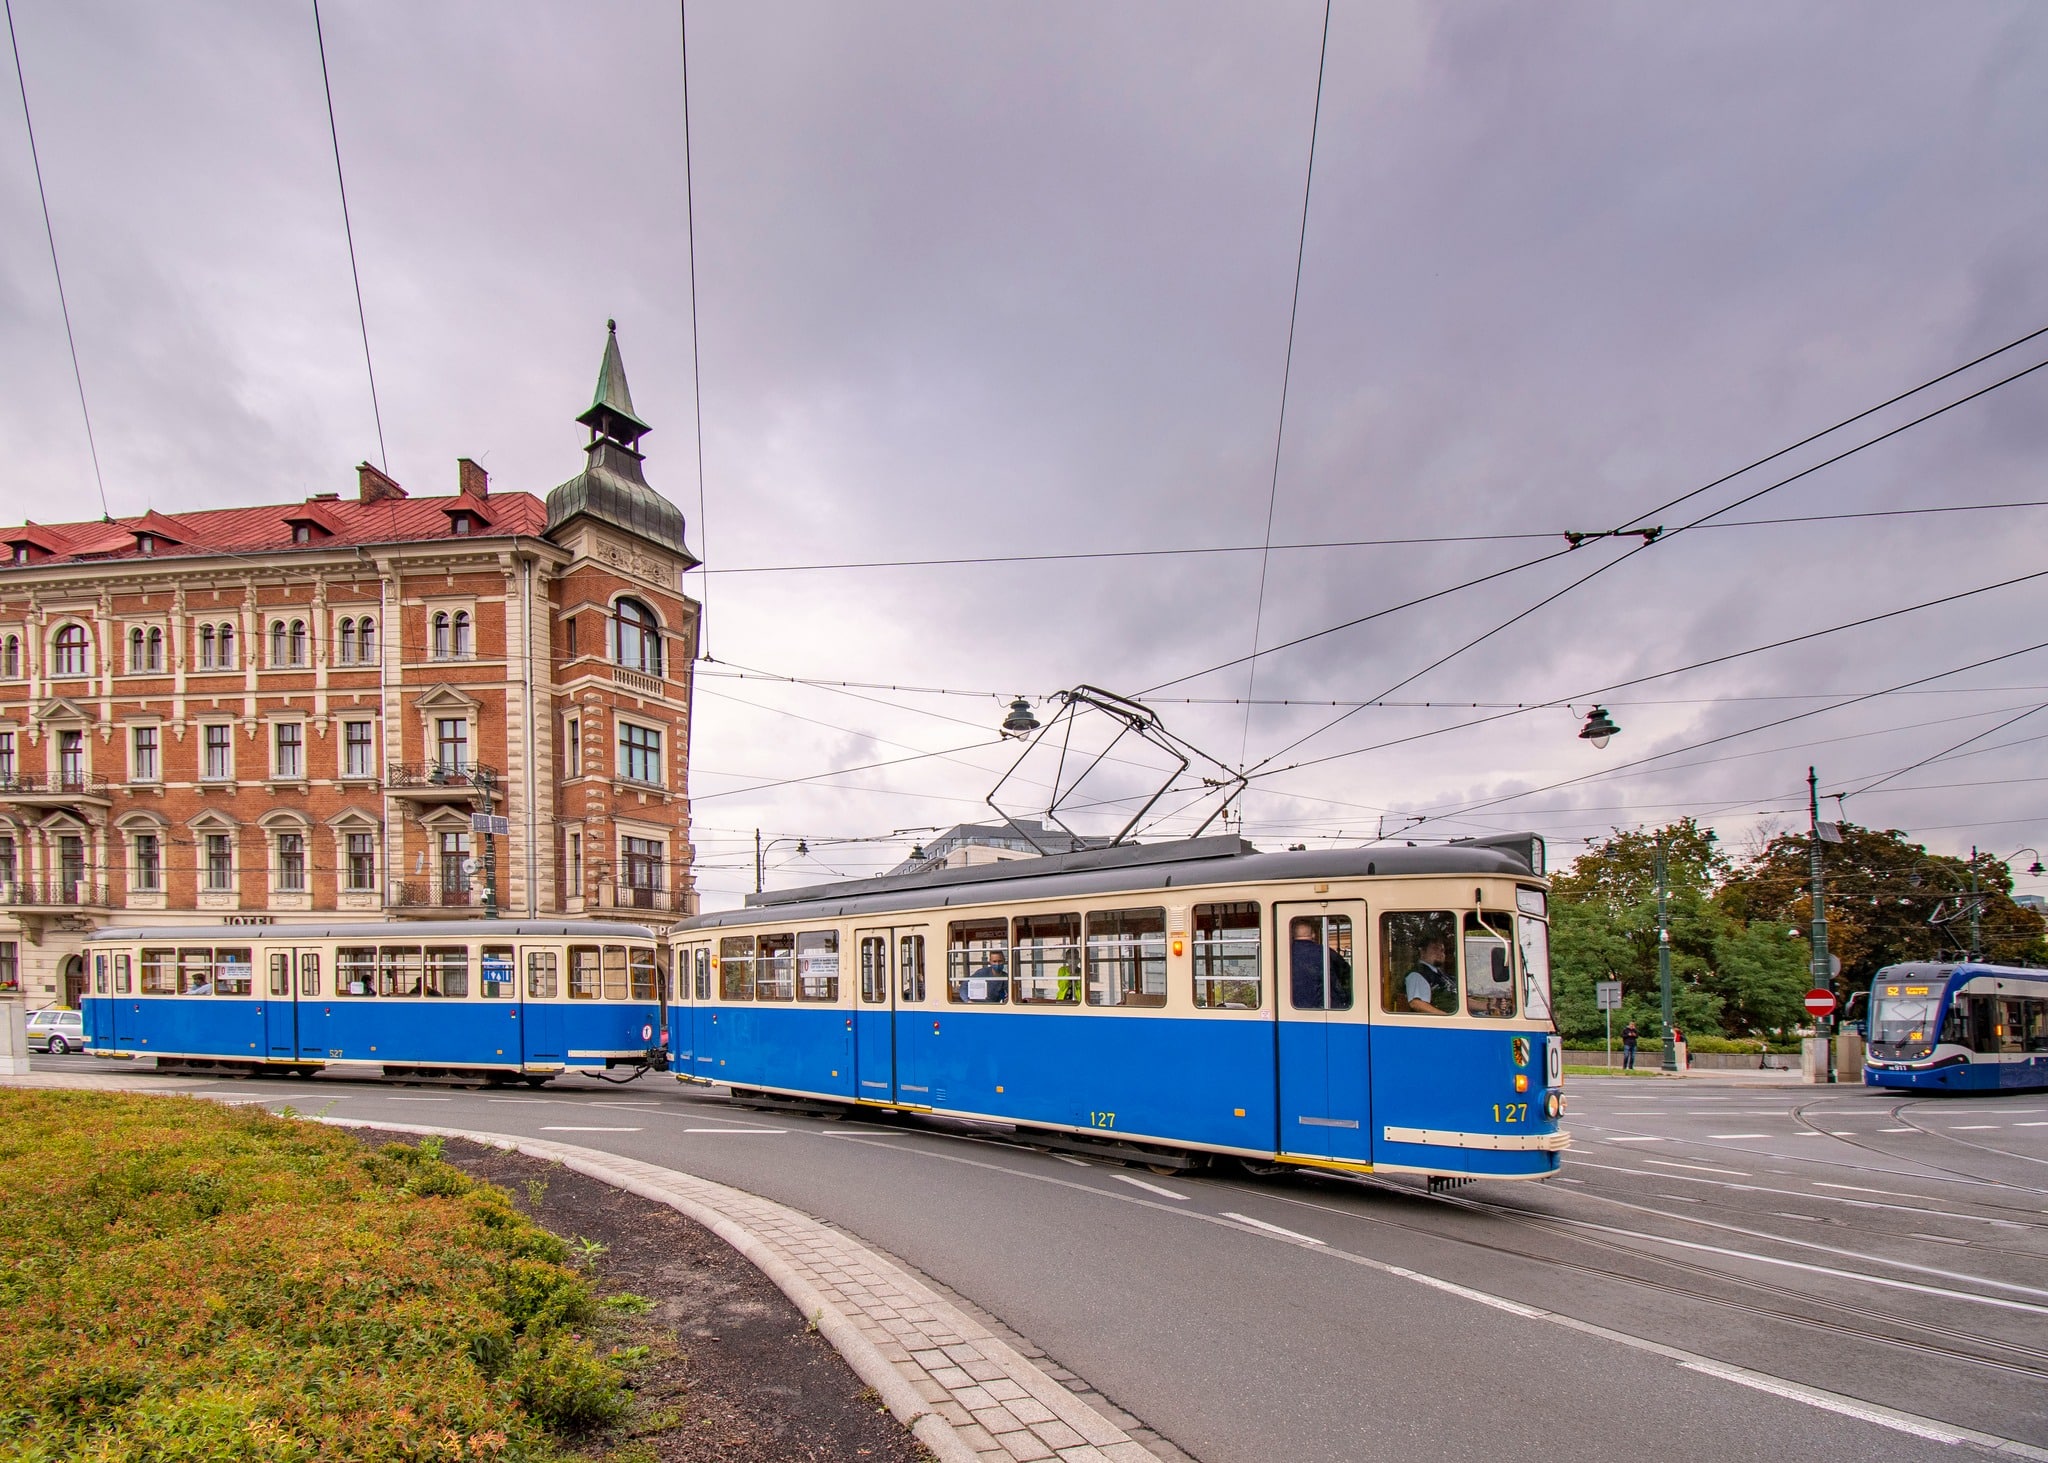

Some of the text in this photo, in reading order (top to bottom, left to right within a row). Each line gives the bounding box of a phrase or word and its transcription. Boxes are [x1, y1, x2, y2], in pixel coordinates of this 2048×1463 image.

[329, 1049, 343, 1058] 527
[1550, 1047, 1559, 1079] 0
[1090, 1111, 1116, 1128] 127
[1492, 1103, 1528, 1123] 127
